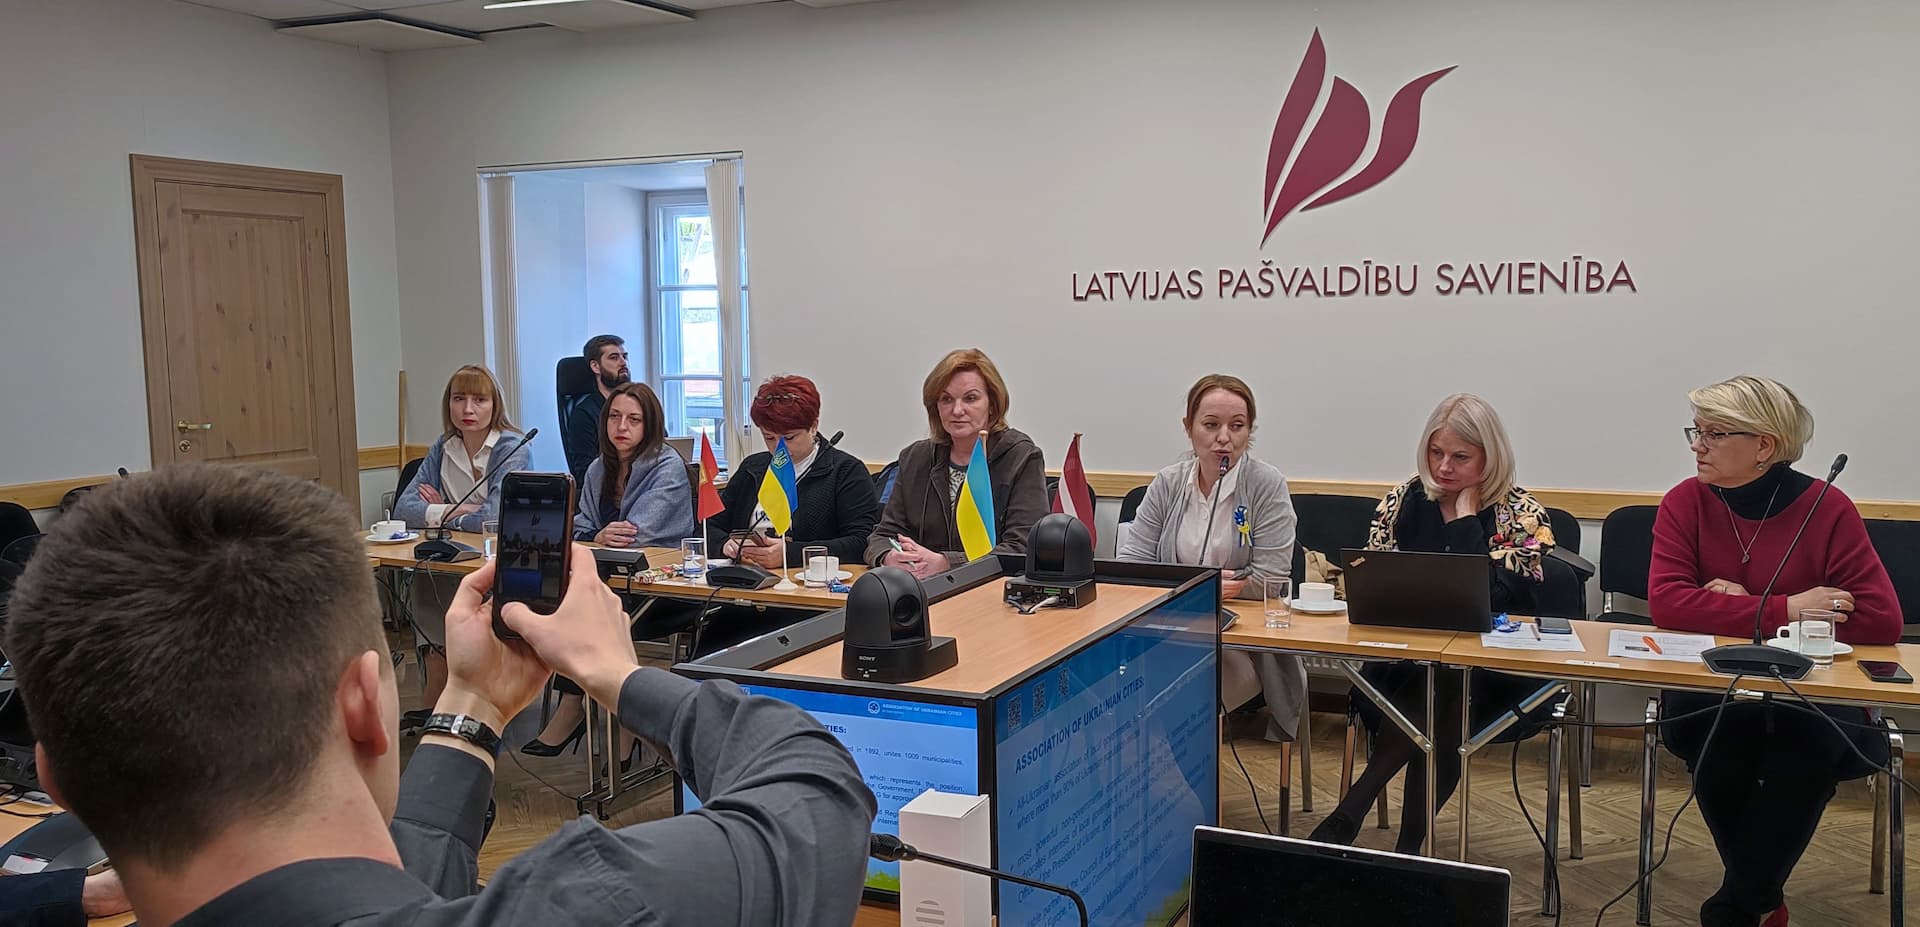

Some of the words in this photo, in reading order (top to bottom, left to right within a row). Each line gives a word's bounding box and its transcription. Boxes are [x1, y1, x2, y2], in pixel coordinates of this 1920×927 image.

[1073, 269, 1203, 301] LATVIJAS
[1219, 259, 1418, 299] PAŠVALDĪBU
[1435, 255, 1637, 296] SAVIENĪBA
[824, 724, 847, 734] TIES:
[1015, 723, 1069, 773] ASSOCIATION
[1072, 715, 1081, 734] OF
[1083, 690, 1120, 726] UKRAINIAN
